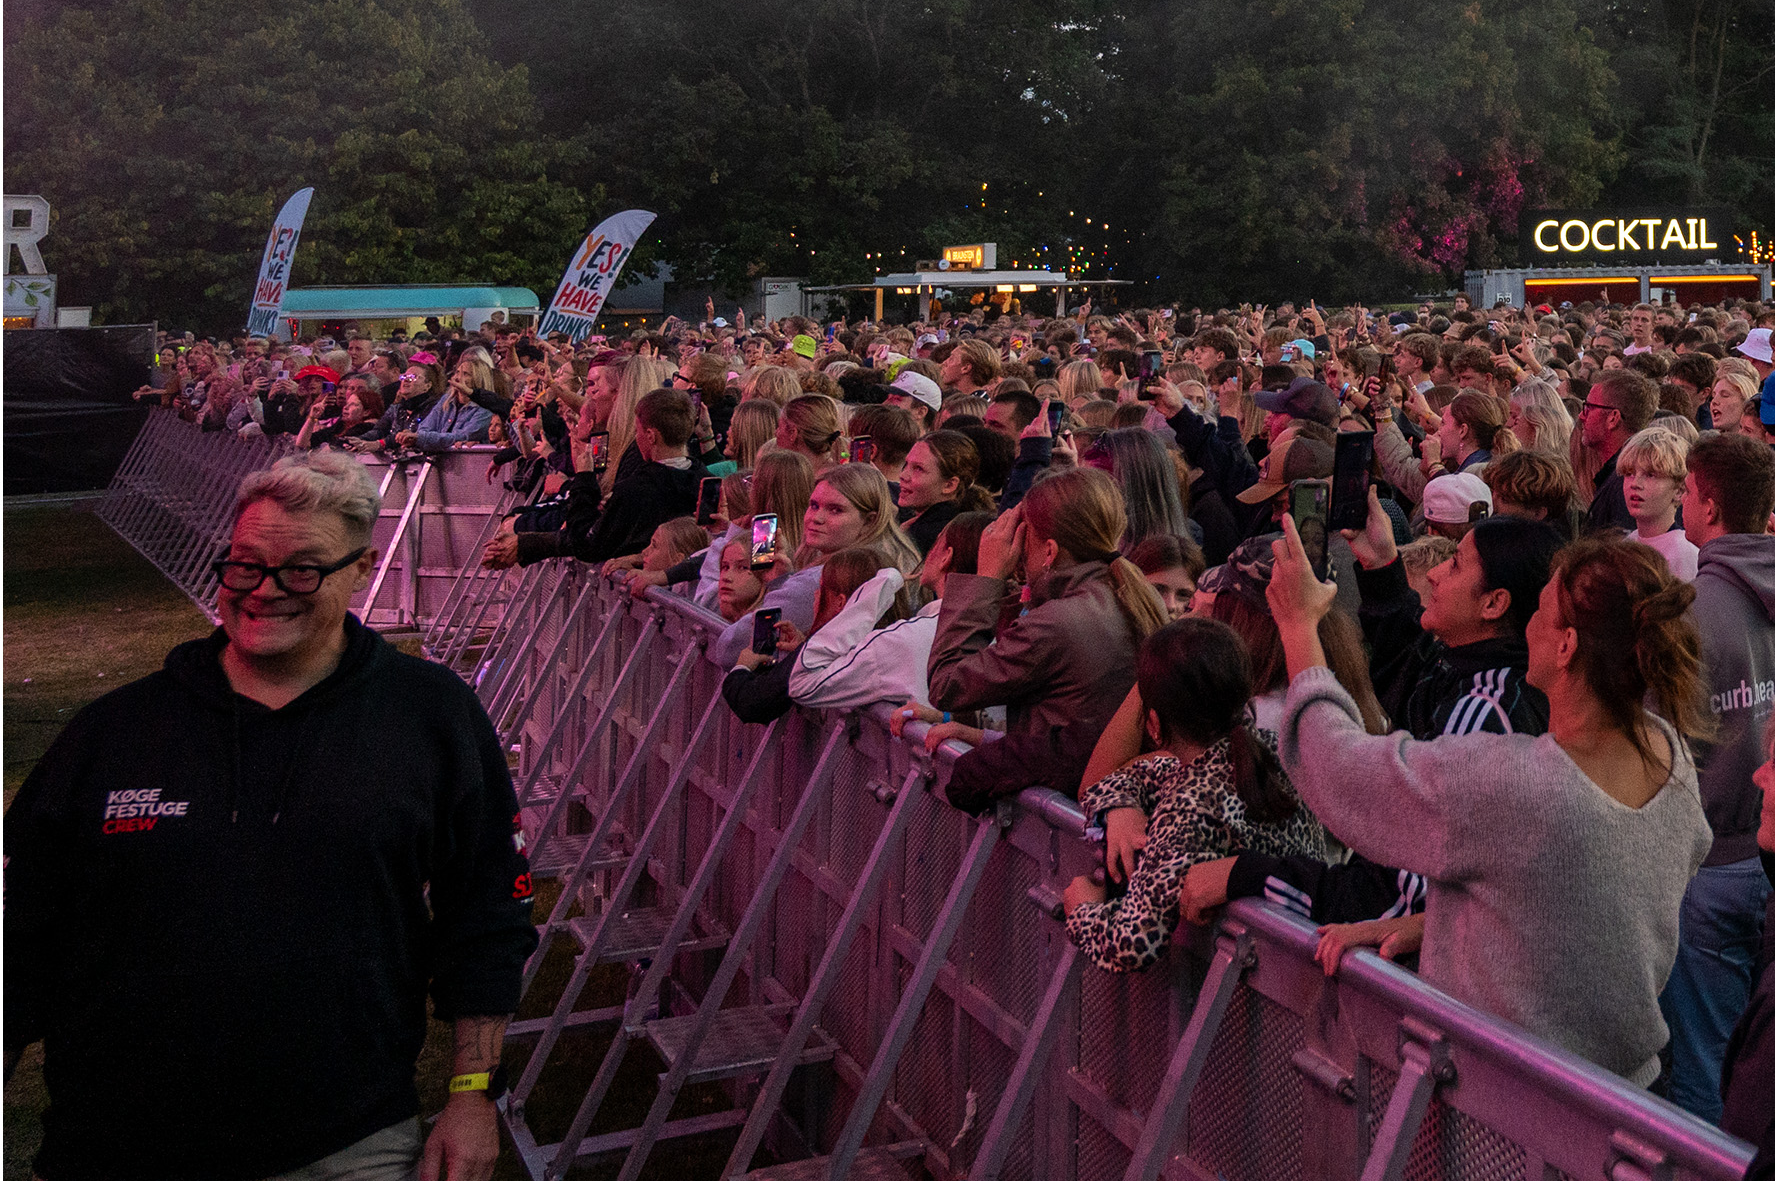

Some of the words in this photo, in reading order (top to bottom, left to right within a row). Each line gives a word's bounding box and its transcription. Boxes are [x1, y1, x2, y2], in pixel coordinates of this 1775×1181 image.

[1534, 218, 1718, 252] COCKTAIL
[576, 234, 630, 279] YES!
[267, 262, 285, 280] WE
[578, 270, 603, 291] WE
[554, 282, 602, 314] HAVE
[107, 788, 163, 804] KØGE
[105, 801, 191, 820] FESTUGE
[102, 817, 159, 835] CREW
